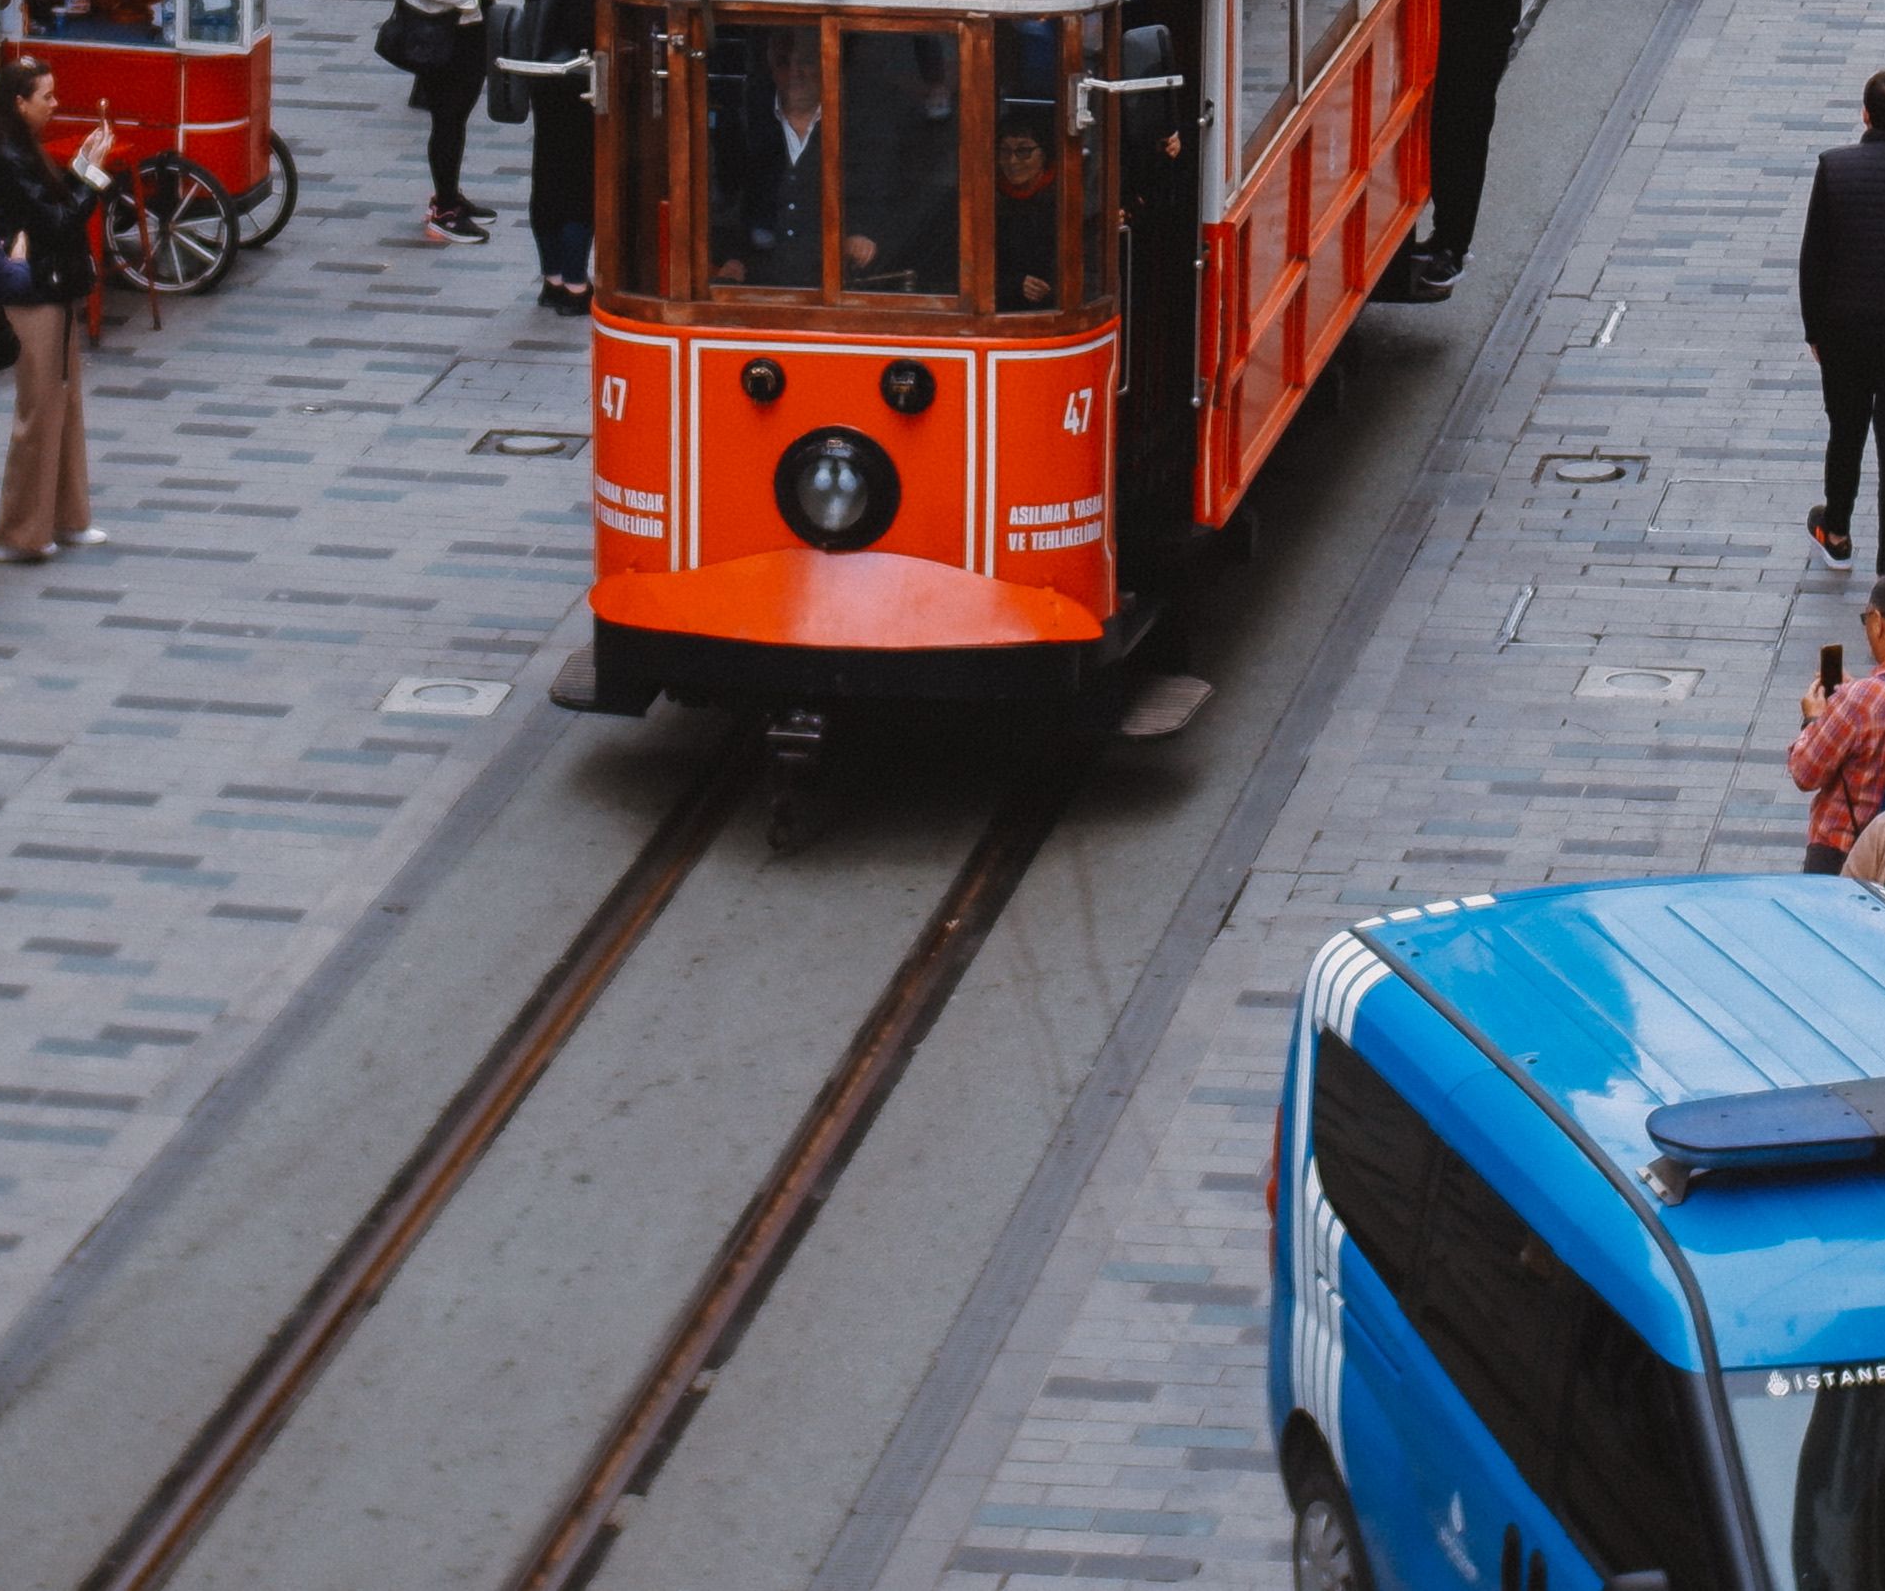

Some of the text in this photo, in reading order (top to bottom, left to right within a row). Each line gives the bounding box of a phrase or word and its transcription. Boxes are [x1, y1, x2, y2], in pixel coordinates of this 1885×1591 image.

[601, 374, 628, 422] 47
[1063, 387, 1093, 436] 47
[623, 487, 665, 513] YASAK
[1009, 501, 1070, 526] ASILMAK
[1008, 531, 1026, 552] VE
